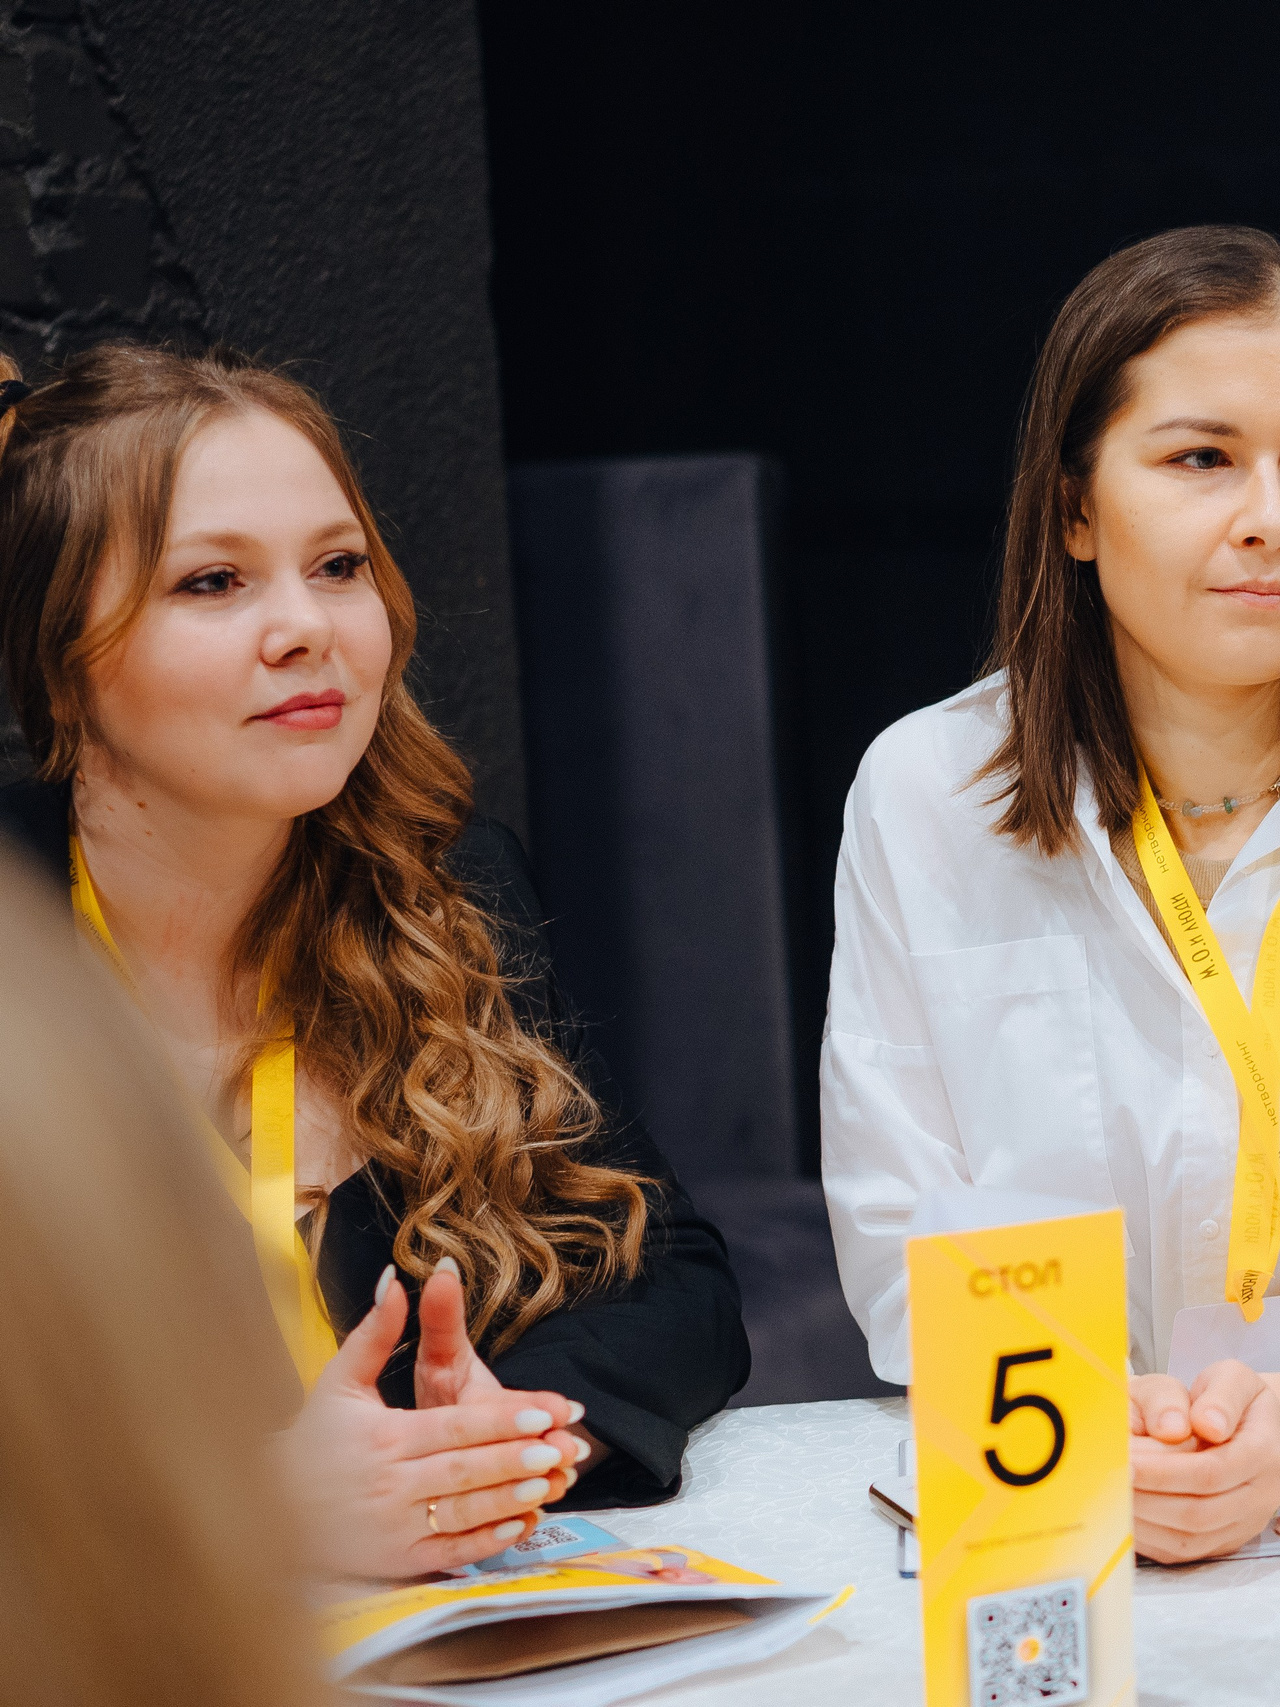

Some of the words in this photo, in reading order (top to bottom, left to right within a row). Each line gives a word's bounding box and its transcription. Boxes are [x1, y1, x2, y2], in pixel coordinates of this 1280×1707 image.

[1137, 801, 1169, 873] нетворкин
[1236, 1040, 1278, 1127] нетворкинг
[967, 1258, 1062, 1299] СТОЛ
[985, 1348, 1065, 1487] 5
